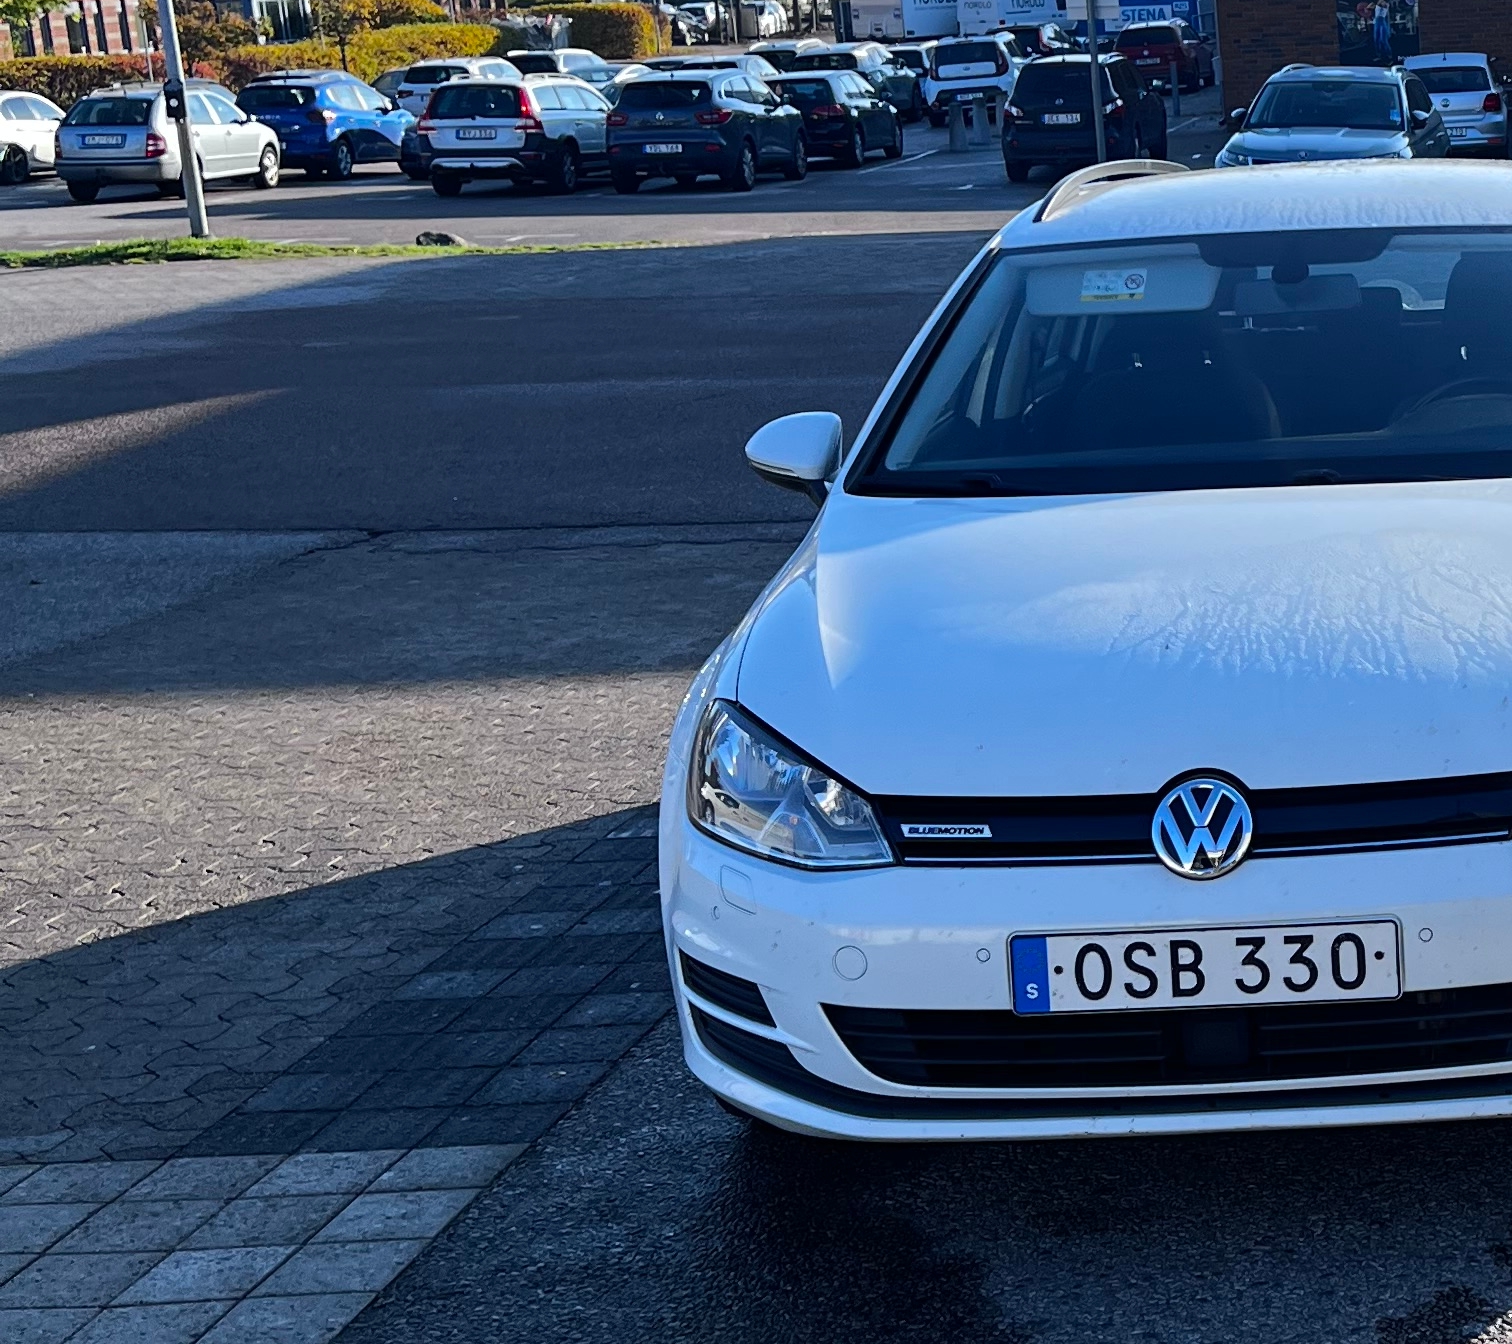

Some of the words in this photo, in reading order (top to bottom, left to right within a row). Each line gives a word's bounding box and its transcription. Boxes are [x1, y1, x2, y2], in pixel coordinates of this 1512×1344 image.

[1121, 7, 1167, 23] STENA
[908, 826, 985, 835] BLUEMOTION
[1026, 983, 1039, 1000] S
[1074, 939, 1206, 1001] OSB
[1235, 932, 1366, 995] 330
